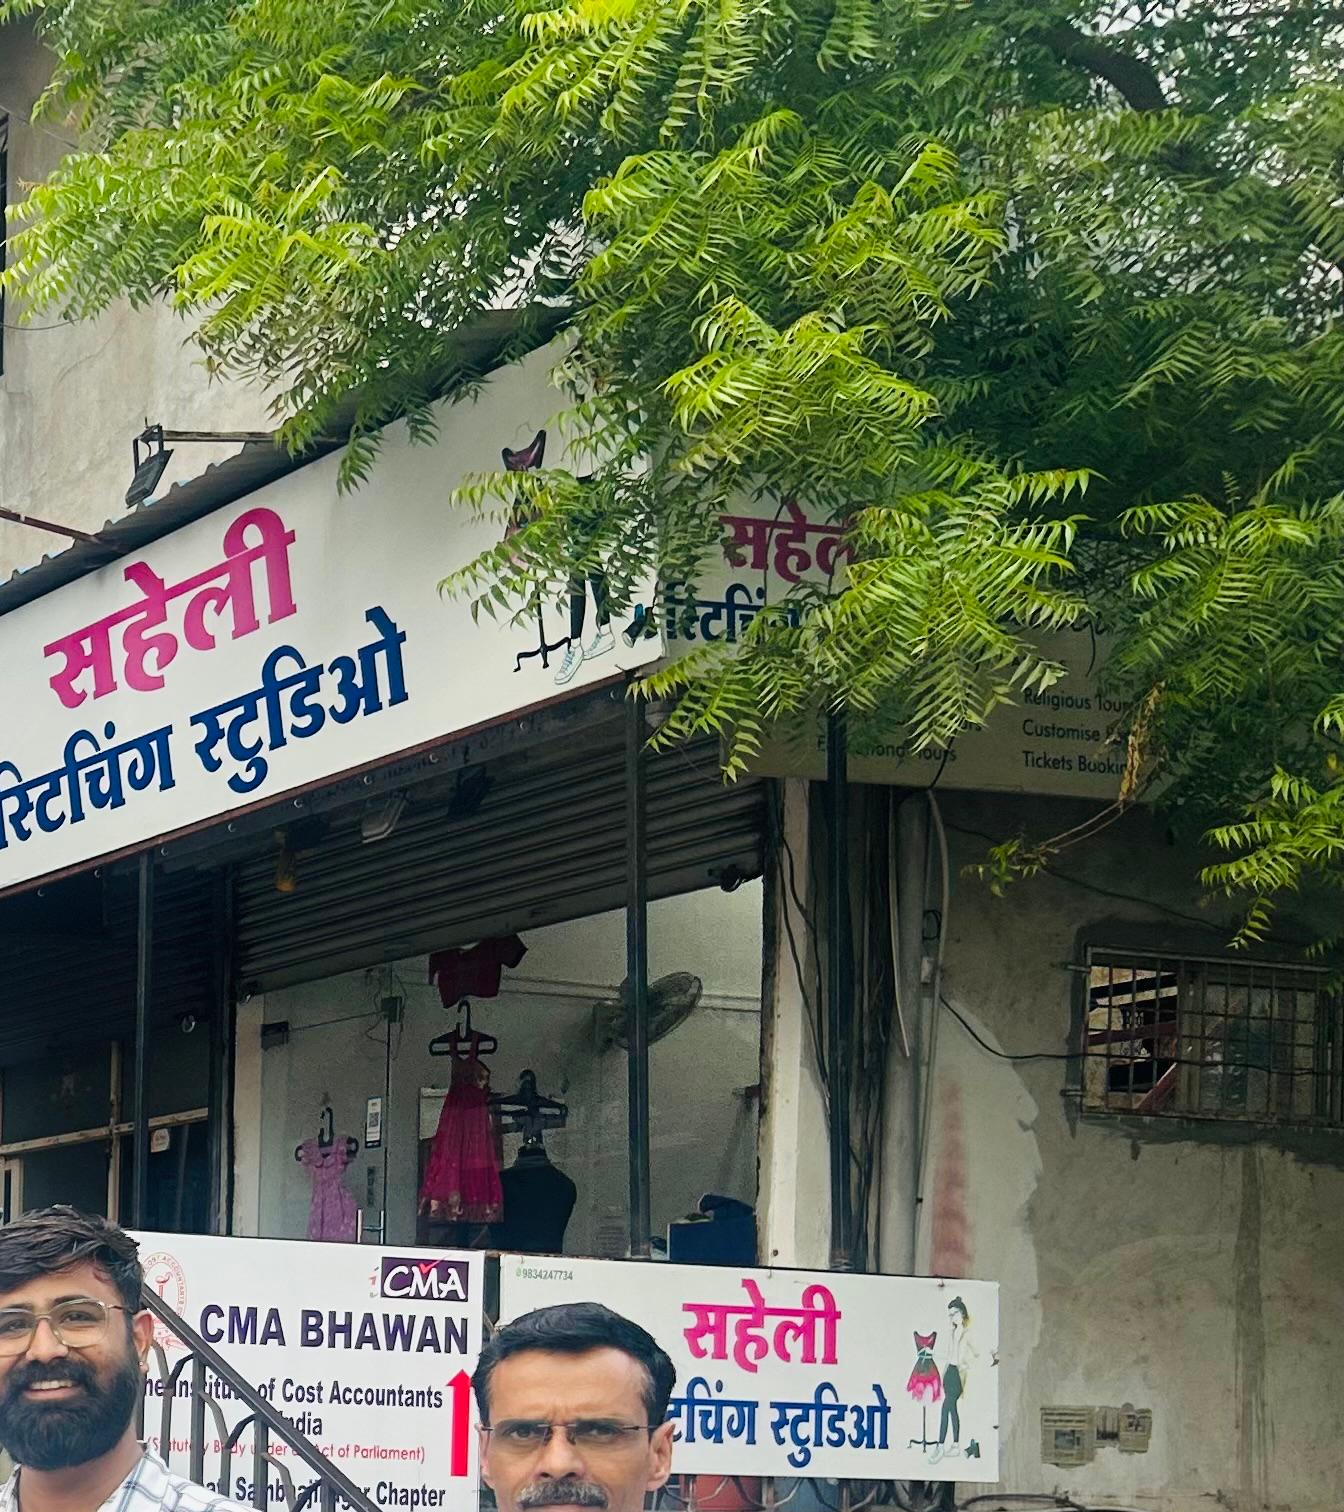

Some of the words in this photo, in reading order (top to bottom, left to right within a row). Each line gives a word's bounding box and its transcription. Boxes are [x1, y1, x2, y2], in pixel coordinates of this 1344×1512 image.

[44, 507, 297, 710] सहेली
[189, 605, 409, 794] स्टुडिओ
[1022, 719, 1101, 742] Customise
[1022, 751, 1074, 771] Tickets
[383, 1265, 466, 1300] CMA
[522, 1268, 573, 1281] 9834247734
[199, 1304, 286, 1347] CMA
[299, 1309, 469, 1355] BHAWAN
[682, 1278, 841, 1373] सहेली
[258, 1378, 276, 1401] of
[282, 1378, 323, 1403] Cost
[329, 1380, 443, 1409] Accountants
[770, 1381, 891, 1469] स्टुडिओ
[338, 1446, 350, 1459] of
[354, 1446, 425, 1464] Parliament)
[376, 1481, 446, 1512] Chapter
